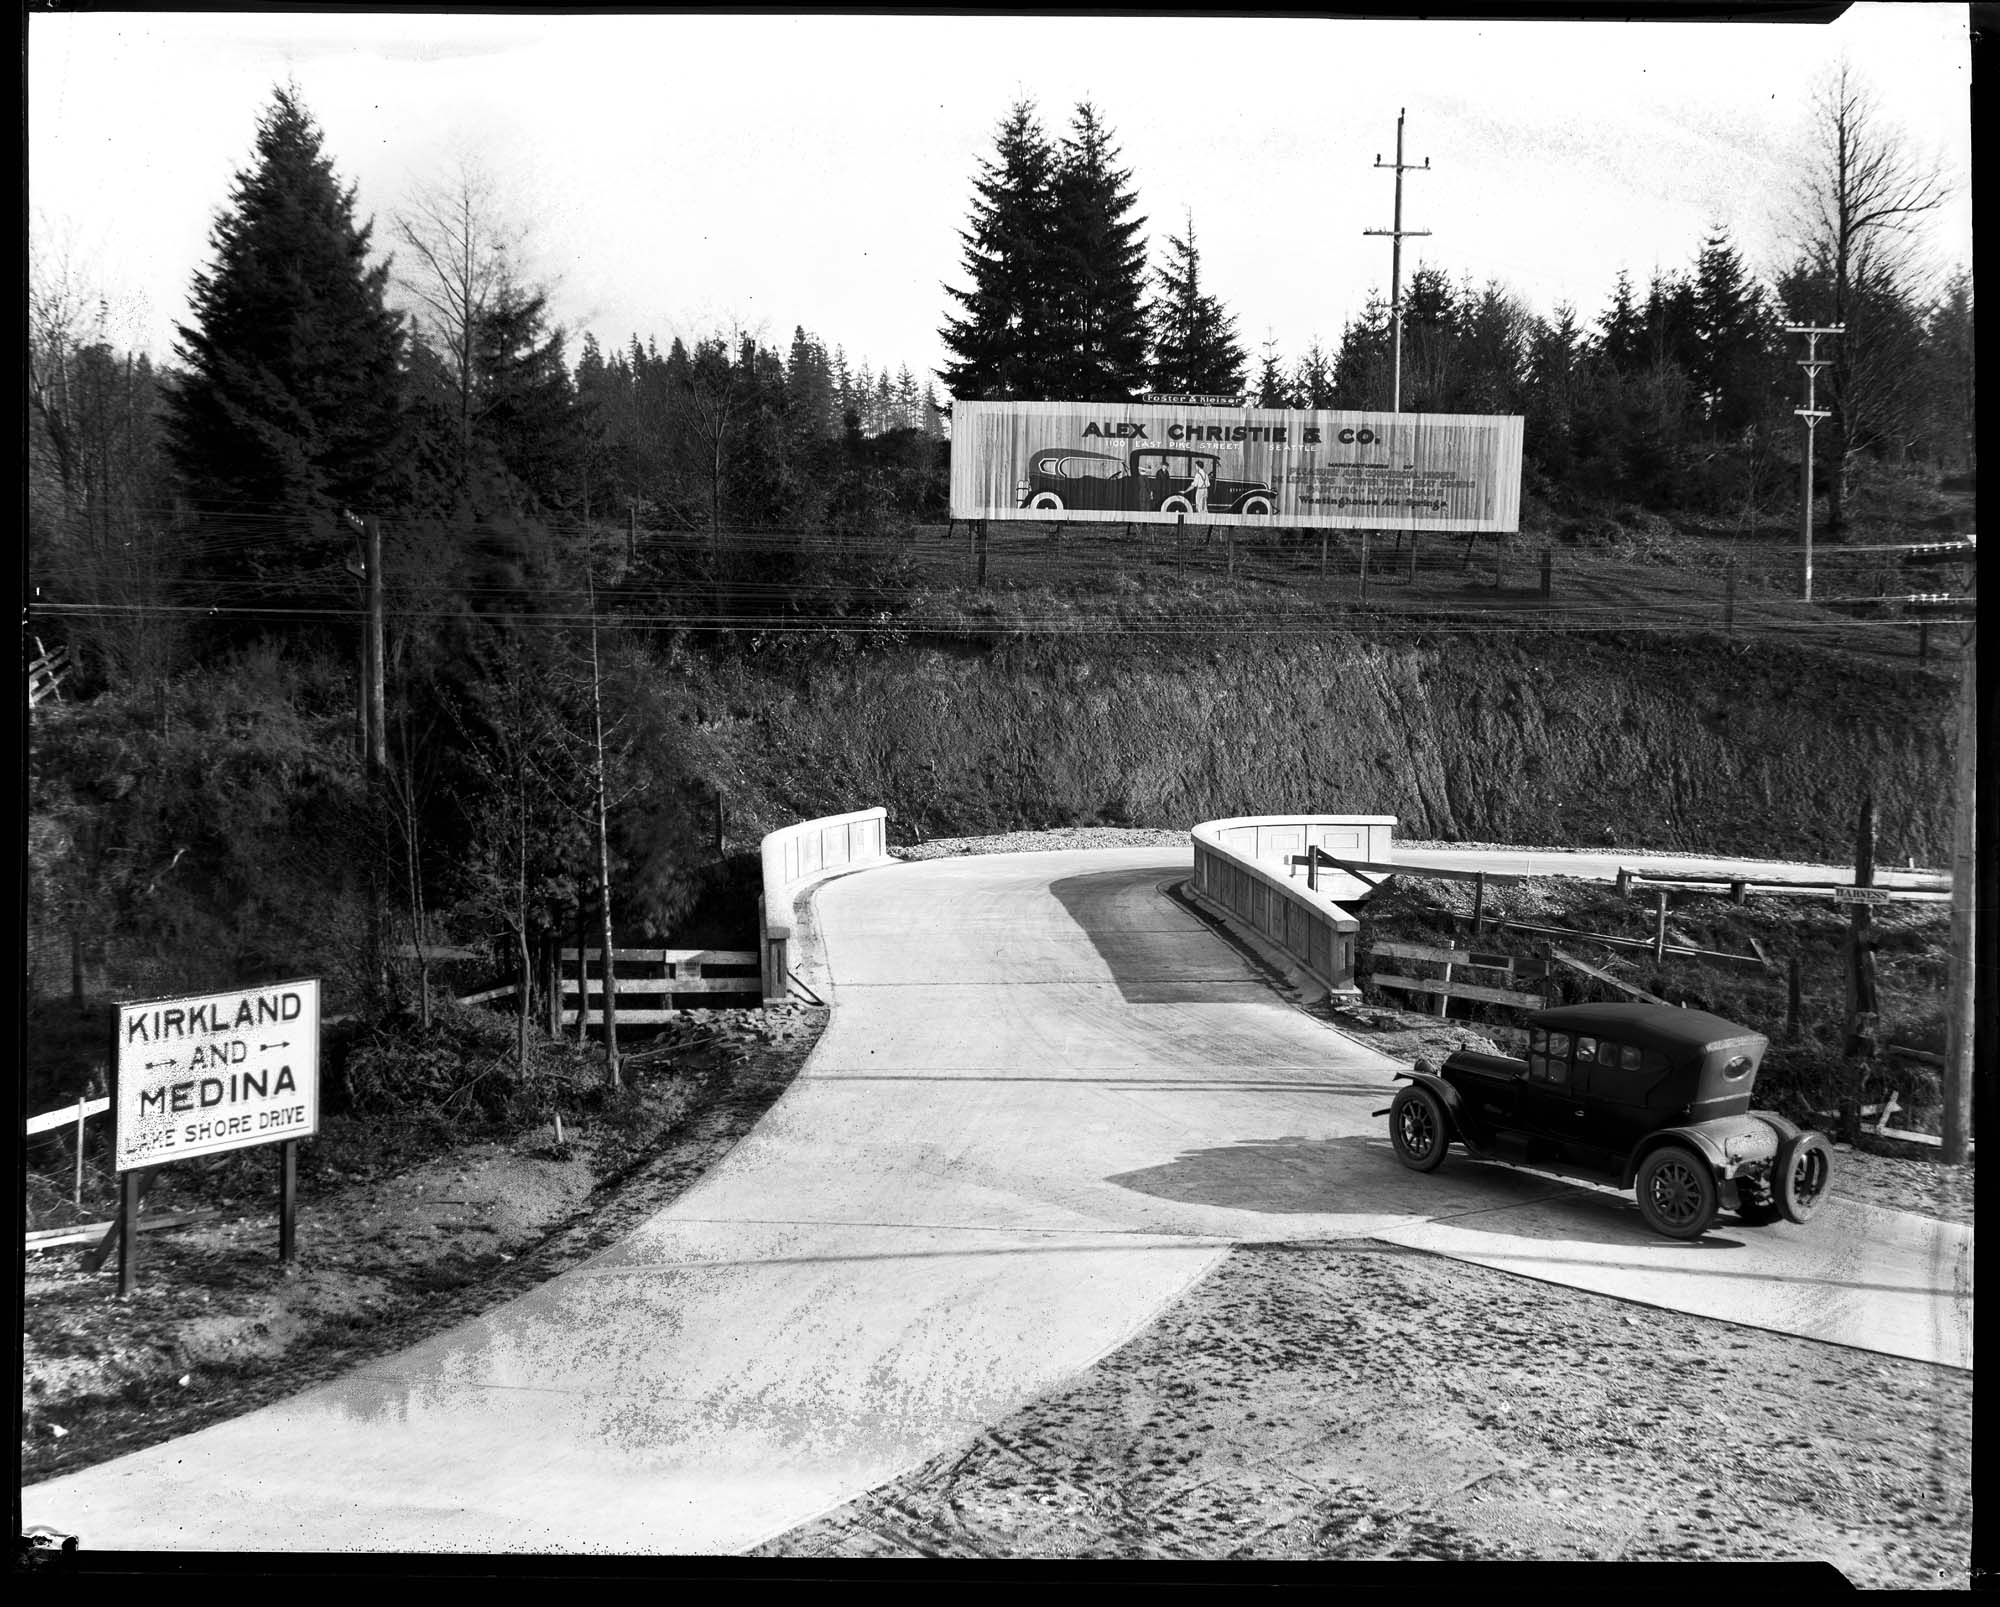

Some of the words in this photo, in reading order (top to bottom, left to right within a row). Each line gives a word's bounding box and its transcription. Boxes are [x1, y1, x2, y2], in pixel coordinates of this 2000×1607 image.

[1147, 394, 1186, 403] Foster
[1189, 395, 1197, 403] &
[1200, 395, 1242, 404] Kleiser
[1081, 421, 1149, 440] ALEX
[1167, 424, 1287, 443] CHRISTIE
[1303, 427, 1322, 444] &
[1338, 428, 1381, 445] CO.
[1105, 440, 1126, 448] 1100
[1135, 441, 1162, 449] EAST
[1169, 441, 1191, 449] PIKE
[1268, 444, 1317, 452] SEATTLE
[1327, 462, 1390, 470] MANUFACTURERS
[1299, 495, 1378, 508] Westinghouse
[1381, 497, 1399, 507] Air
[128, 992, 302, 1043] KIRKLAND
[189, 1040, 248, 1070] AND
[140, 1065, 297, 1117] MEDINA
[184, 1115, 252, 1143] SHORE
[259, 1105, 306, 1129] DRIVE
